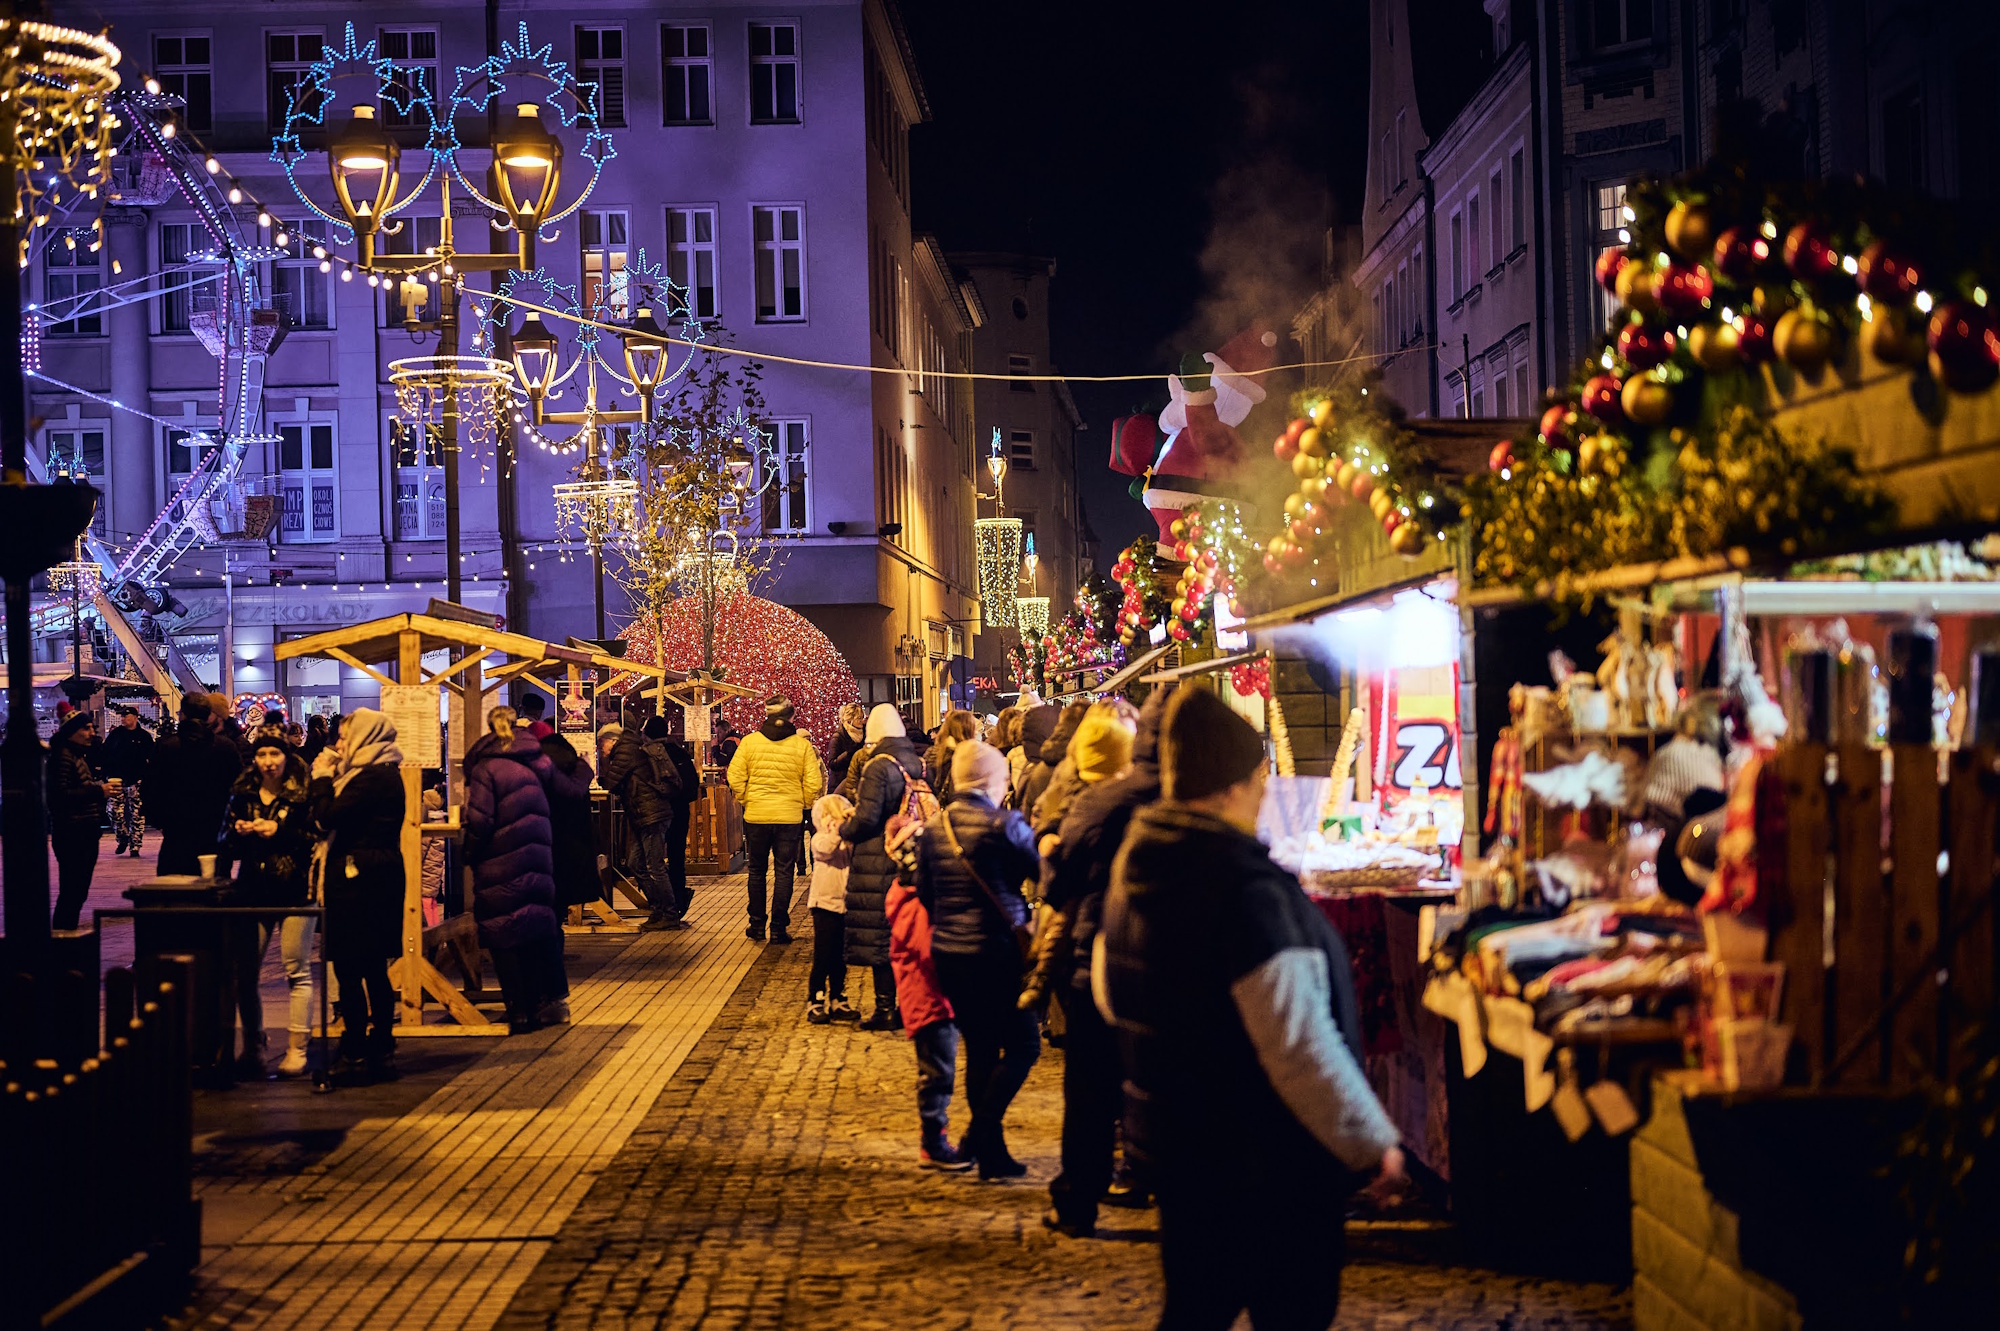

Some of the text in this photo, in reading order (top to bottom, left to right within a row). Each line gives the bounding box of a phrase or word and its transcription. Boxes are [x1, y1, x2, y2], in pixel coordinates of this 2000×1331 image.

[284, 490, 303, 510] IMP
[313, 489, 333, 501] OKOLI
[313, 502, 333, 515] CZNOŚ
[399, 501, 418, 514] WYNA
[431, 503, 445, 511] 519
[283, 512, 304, 529] REZY
[313, 516, 333, 528] CIOWE
[399, 515, 418, 532] JĘCIA
[233, 602, 374, 622] CZEKOLADY
